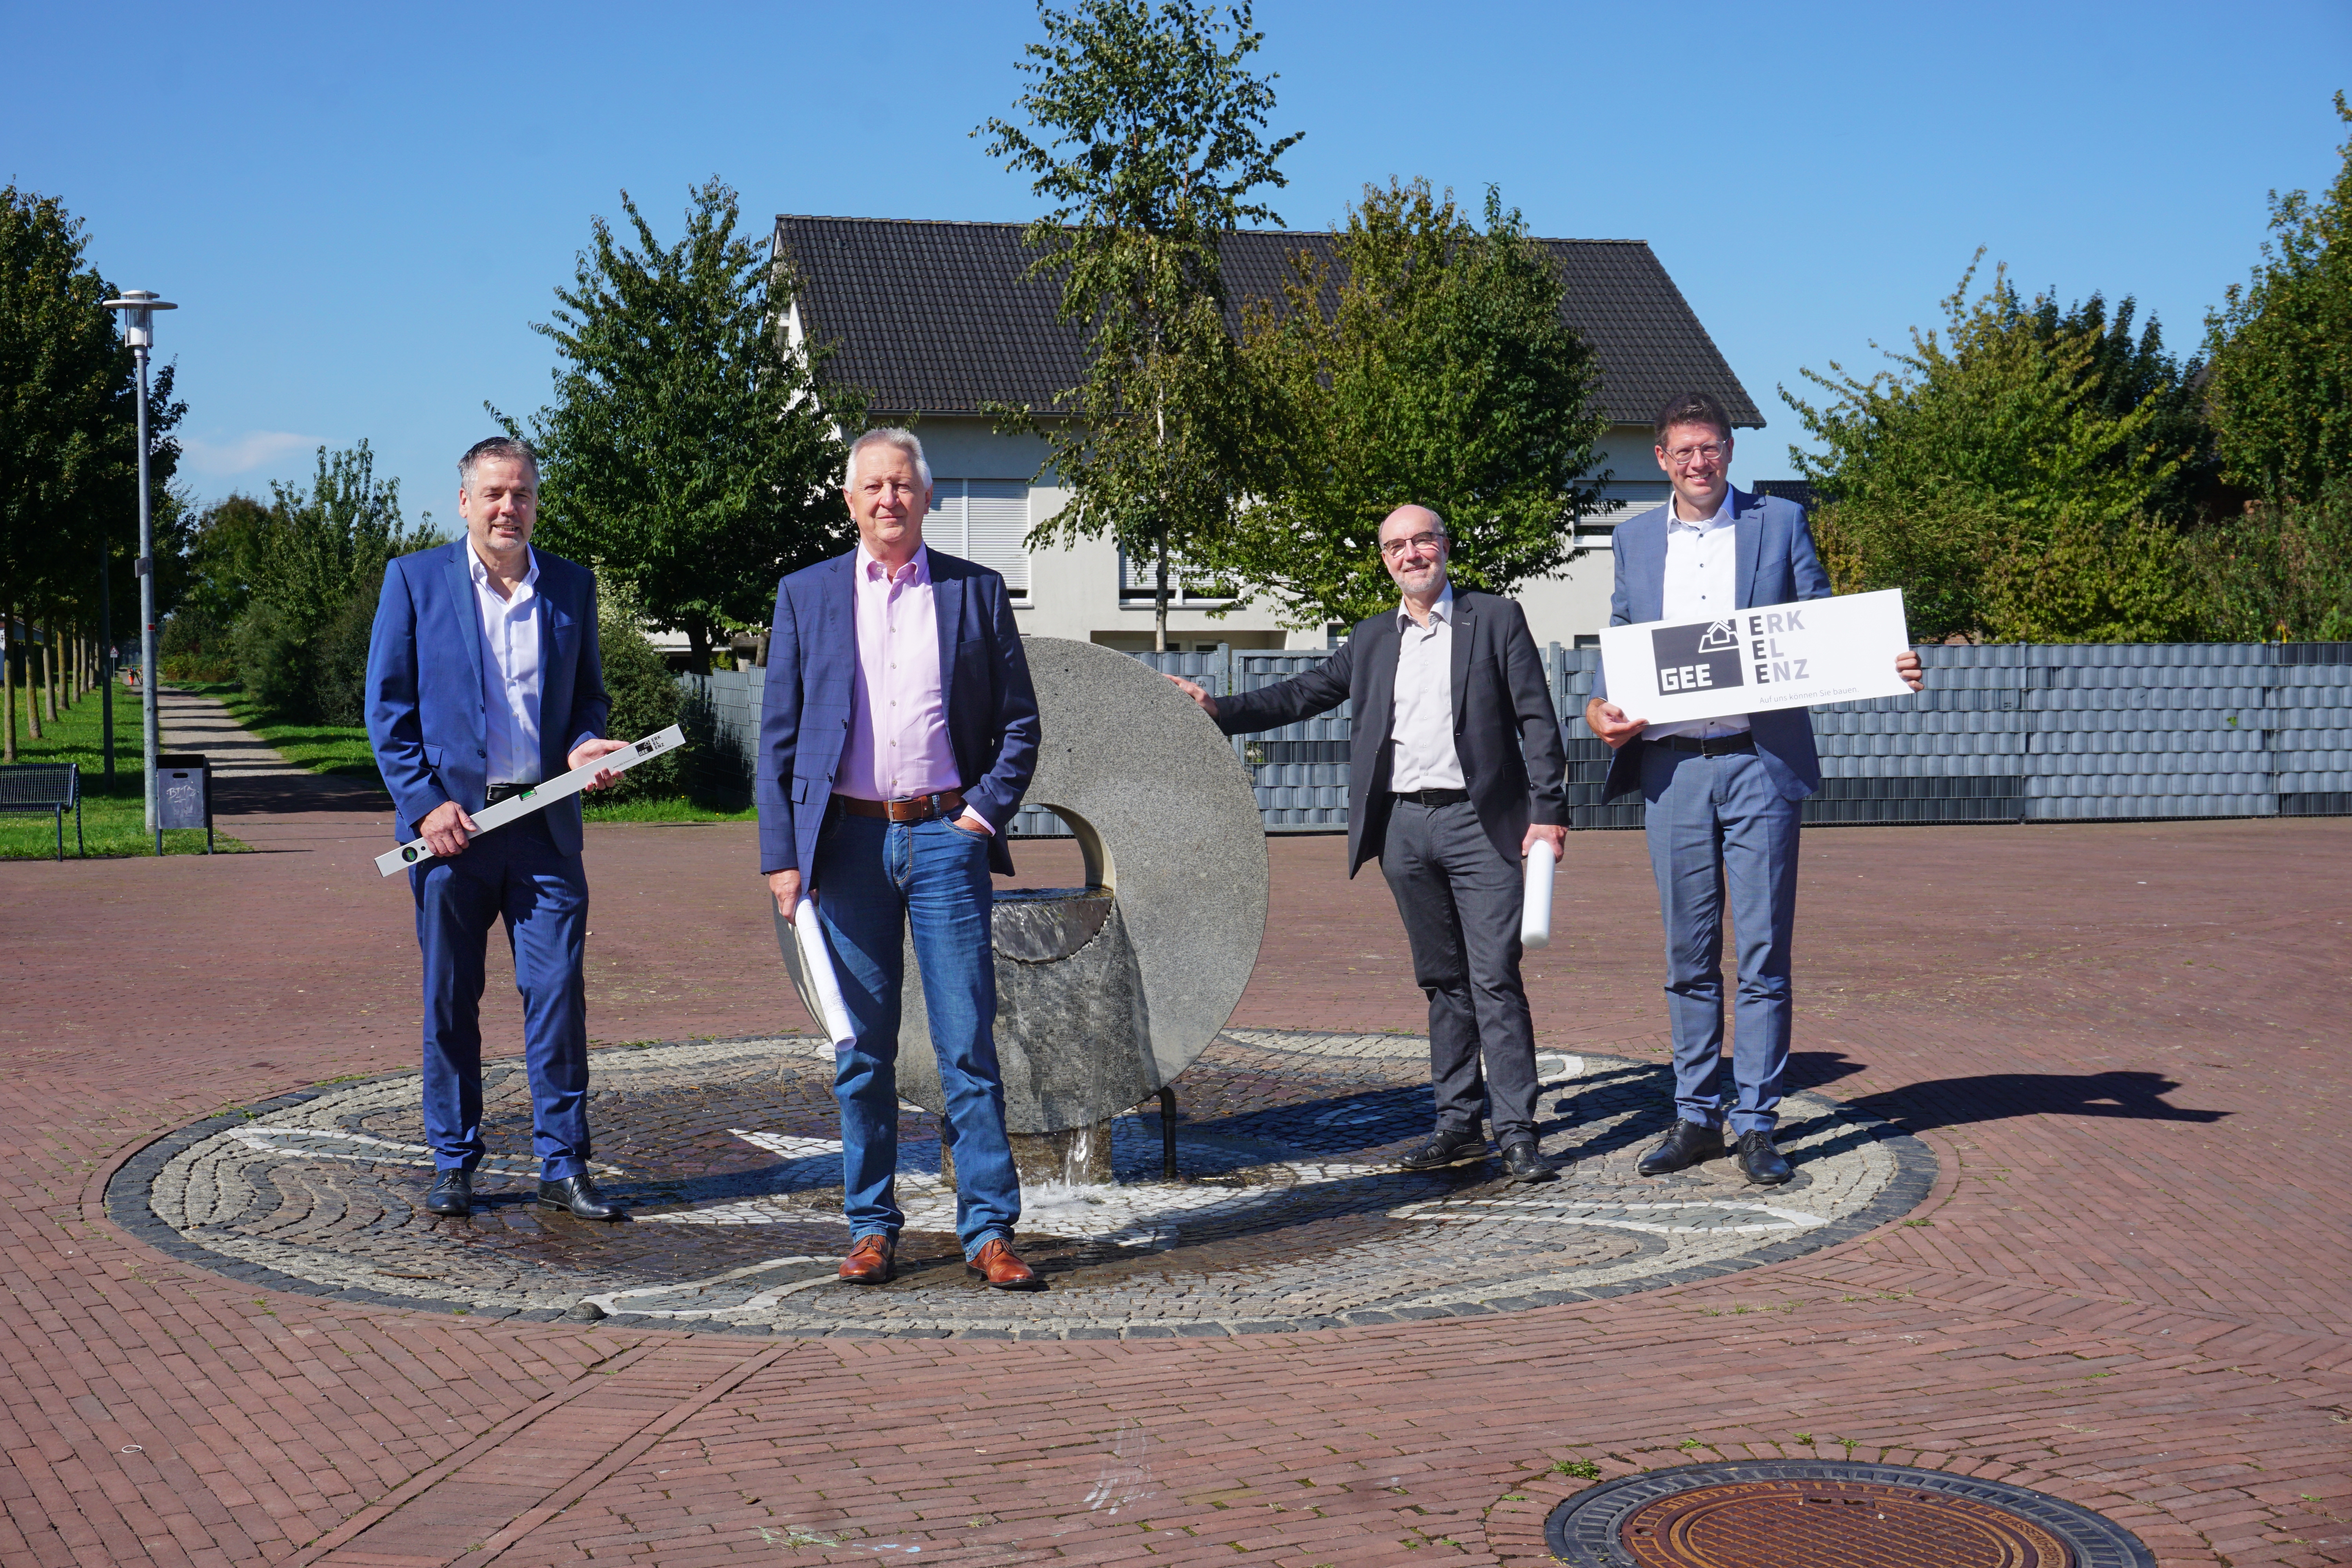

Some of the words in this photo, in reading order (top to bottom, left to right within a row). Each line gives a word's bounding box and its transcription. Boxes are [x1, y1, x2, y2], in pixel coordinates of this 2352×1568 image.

[1749, 610, 1806, 636] ERK
[1752, 638, 1784, 660] EL
[1661, 664, 1713, 691] GEE
[1755, 659, 1810, 684] ENZ
[1760, 695, 1772, 704] Auf
[1789, 691, 1818, 700] können
[1833, 687, 1859, 695] bauen.
[1662, 1486, 1747, 1507] KESSEL
[1992, 1514, 2043, 1537] KLASSE
